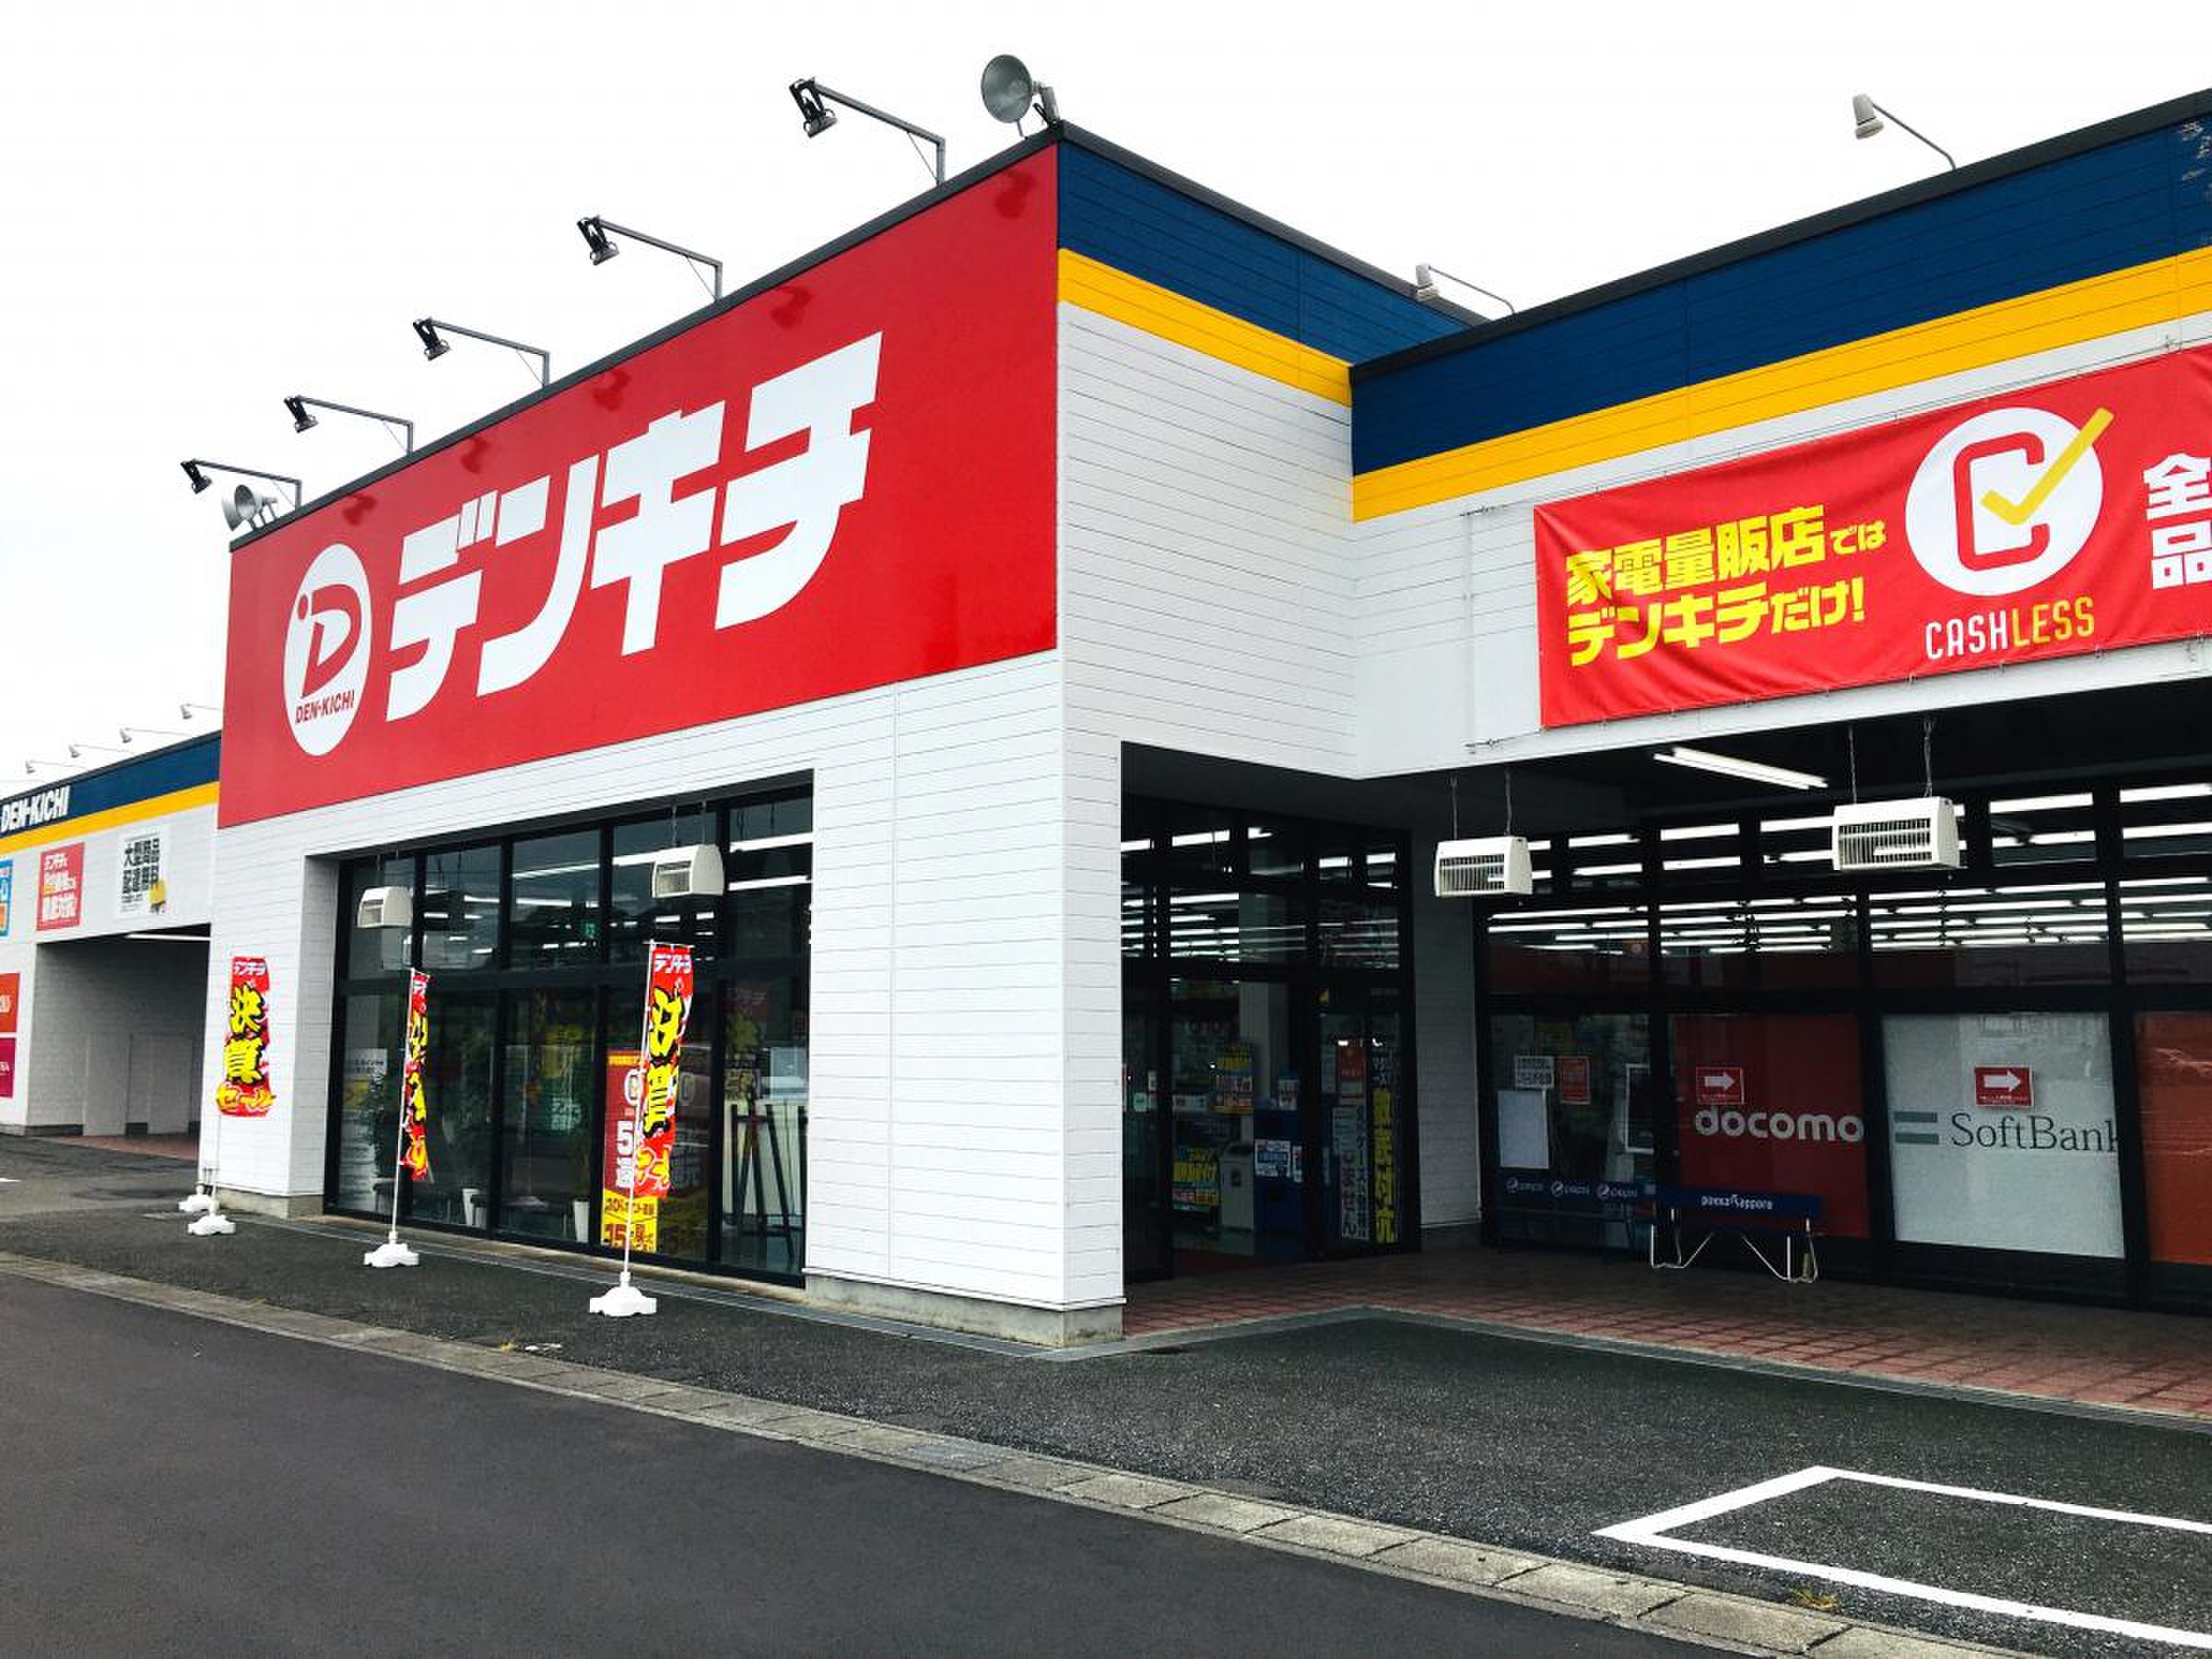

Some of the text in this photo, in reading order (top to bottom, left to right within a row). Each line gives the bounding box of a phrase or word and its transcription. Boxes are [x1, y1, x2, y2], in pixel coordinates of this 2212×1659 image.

[385, 331, 882, 723] デンキチ
[1566, 504, 1888, 606] 家電量販店では
[1924, 595, 2095, 660] CASHLESS
[295, 689, 355, 724] DEN-KICHI
[0, 785, 71, 833] DEN-KICHI
[1695, 1107, 1865, 1143] docomo
[1950, 1112, 2120, 1153] SoftBank
